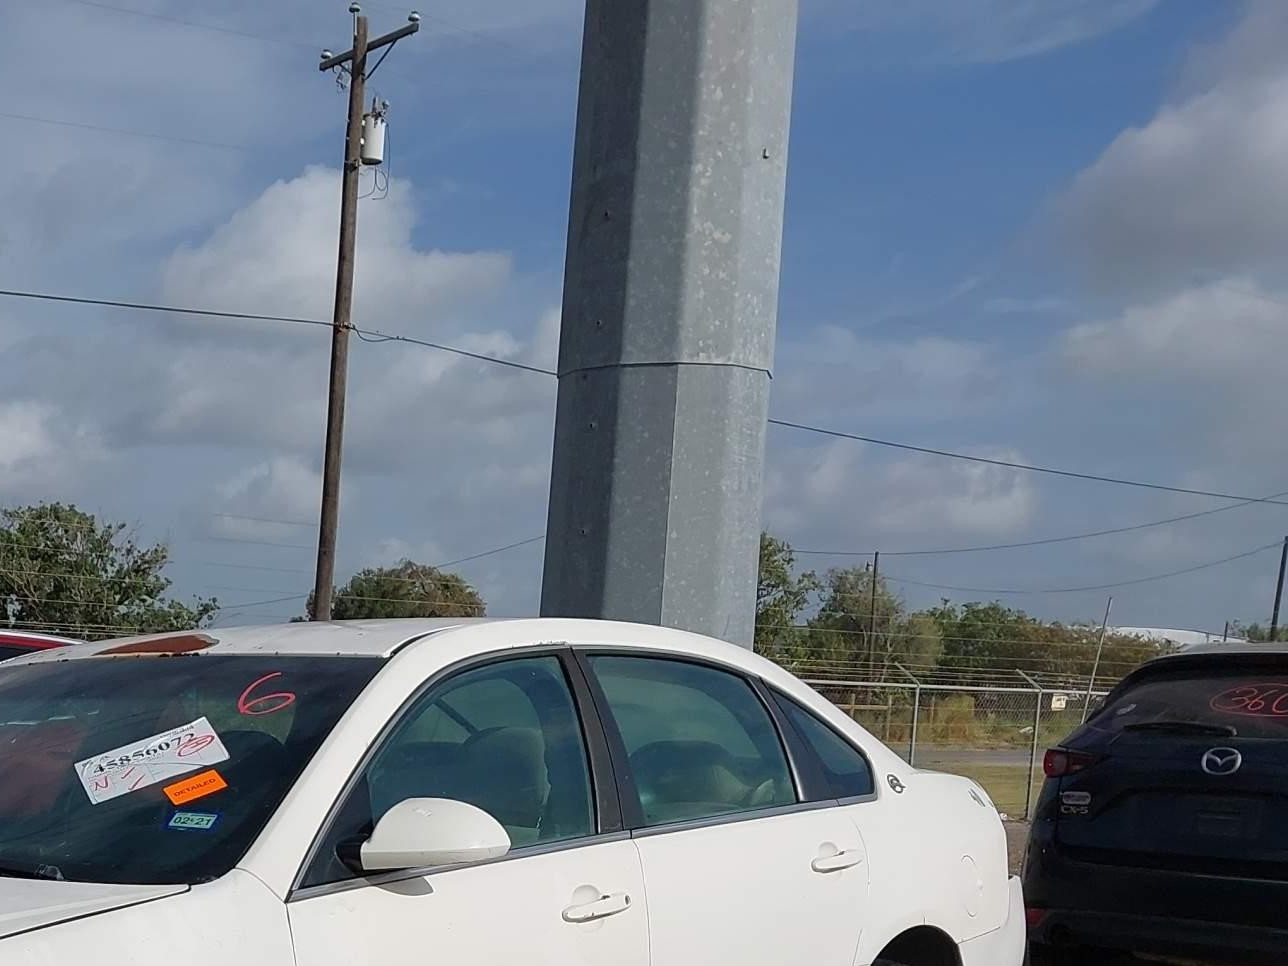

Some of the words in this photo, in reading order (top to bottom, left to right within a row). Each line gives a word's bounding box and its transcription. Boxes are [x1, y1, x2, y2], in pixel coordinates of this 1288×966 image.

[237, 671, 296, 715] 6
[93, 733, 195, 774] 45856072
[173, 778, 216, 797] DETAILED
